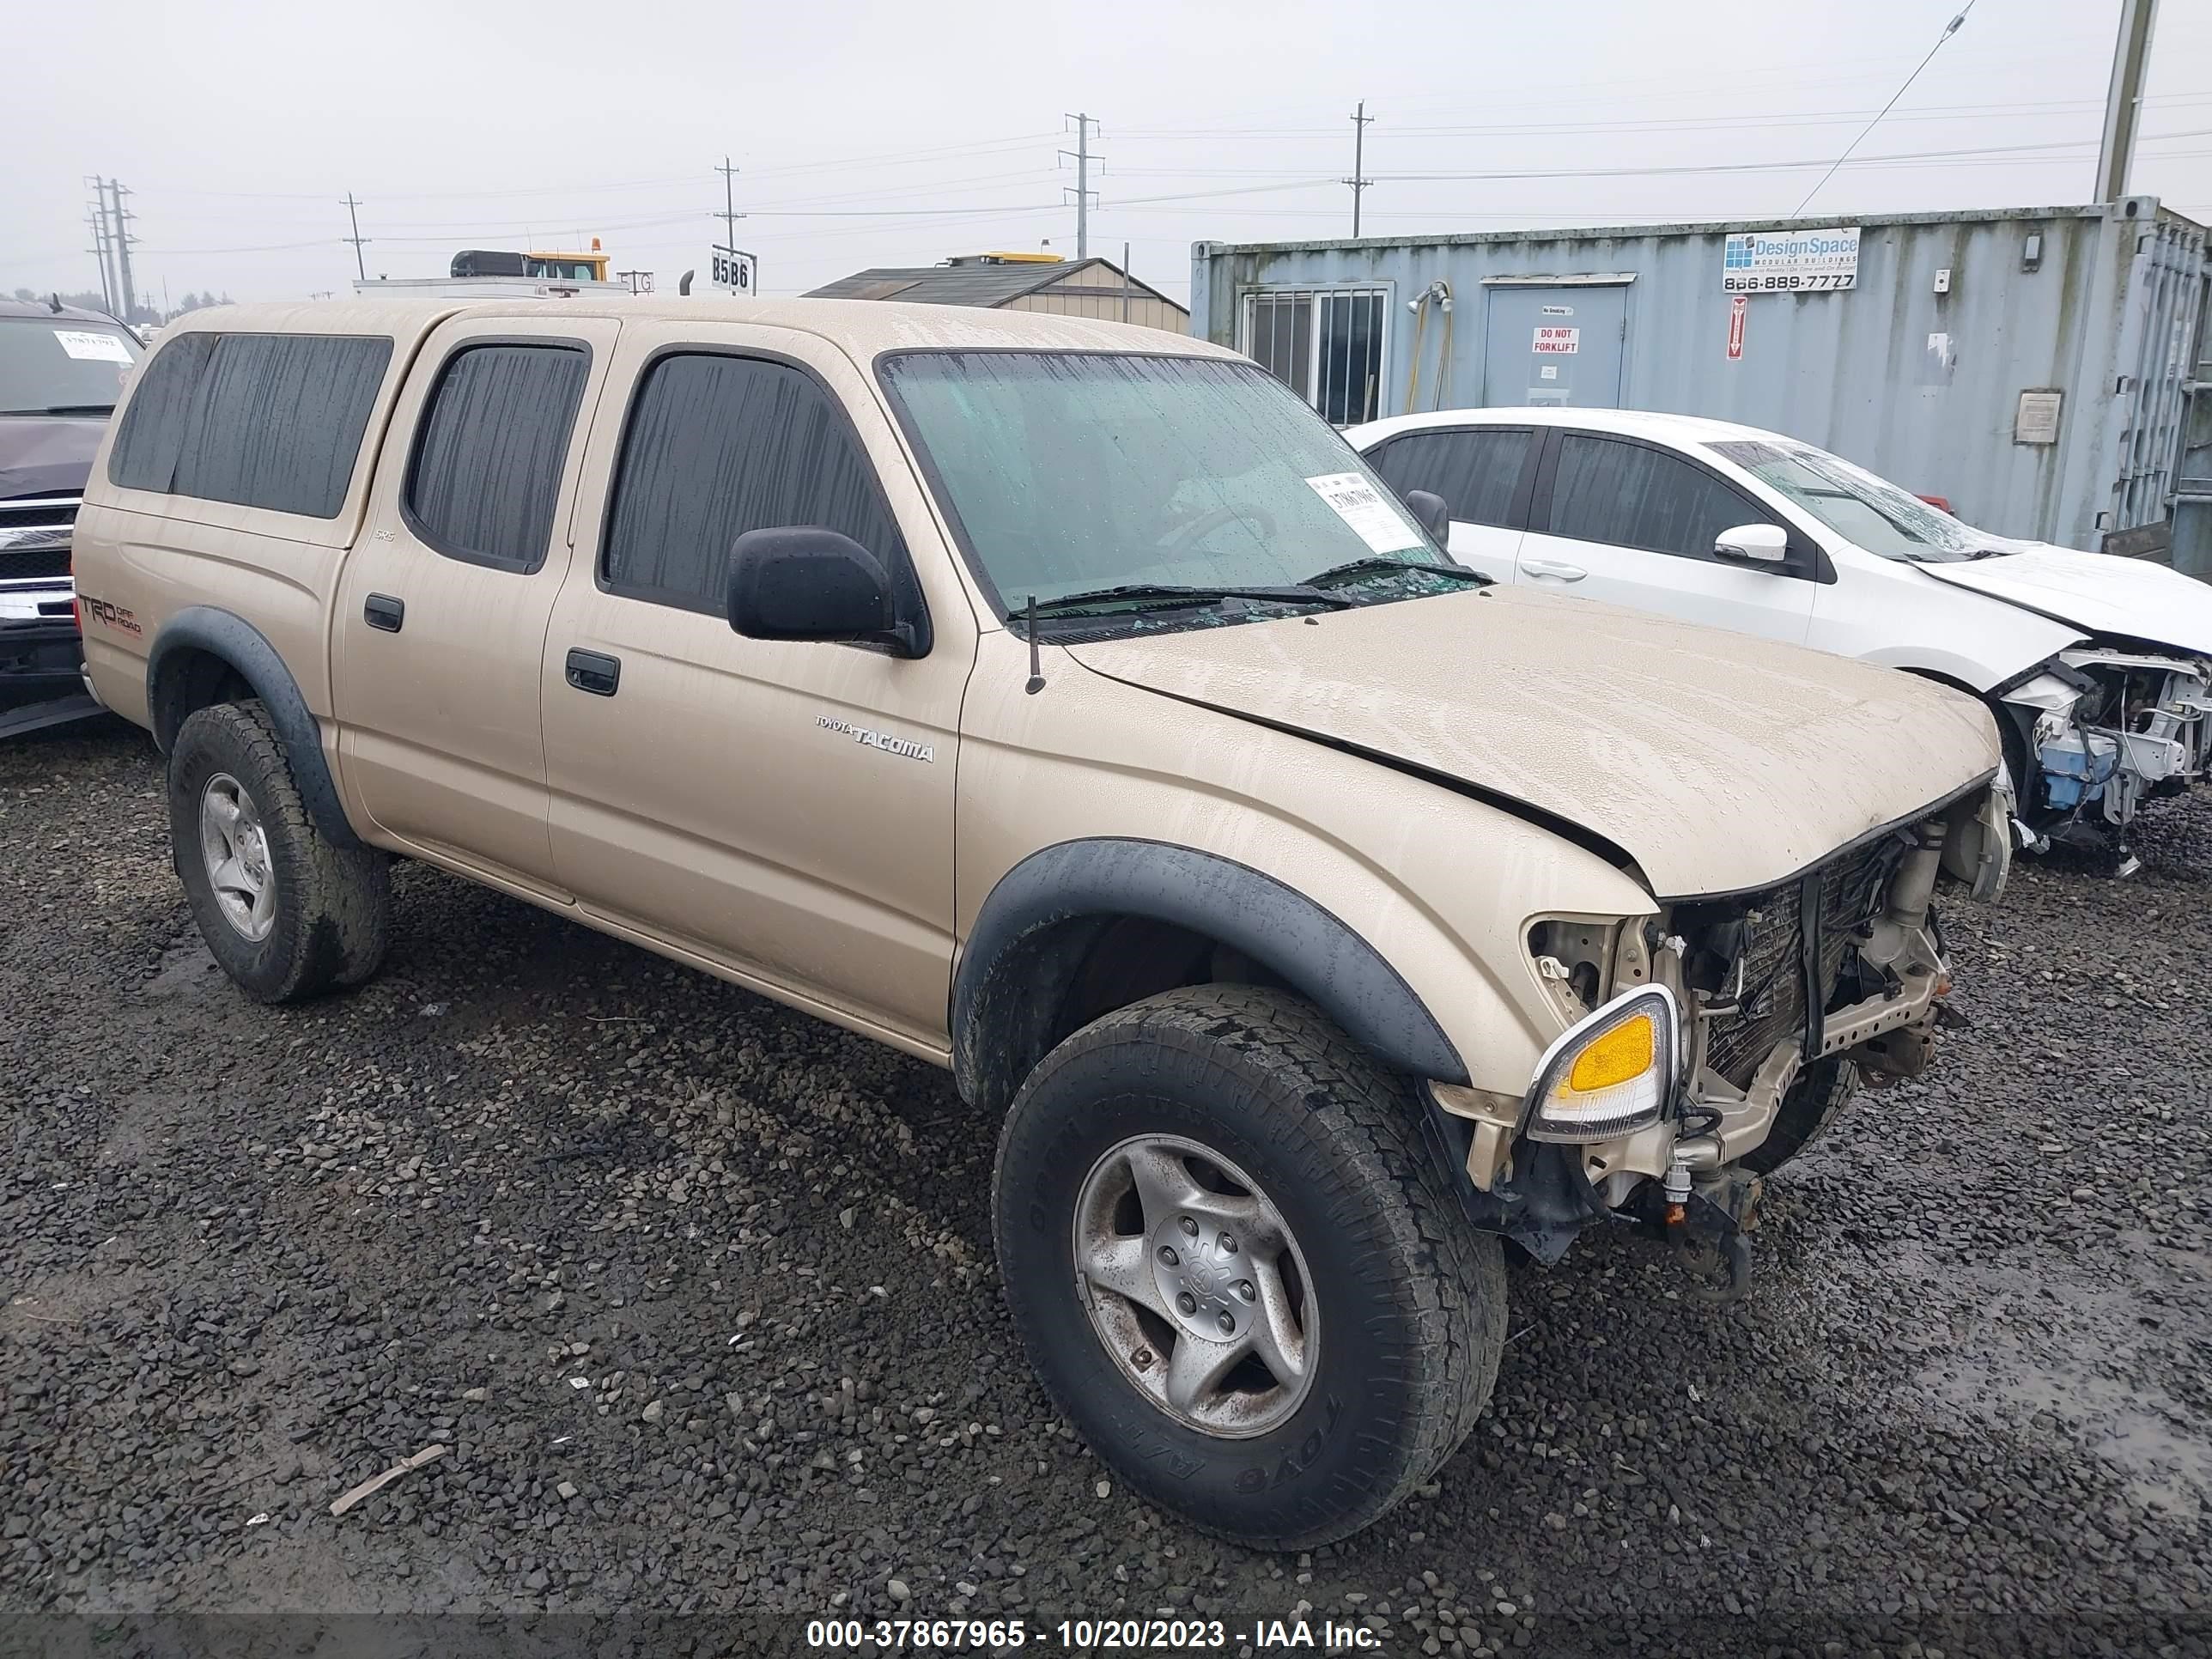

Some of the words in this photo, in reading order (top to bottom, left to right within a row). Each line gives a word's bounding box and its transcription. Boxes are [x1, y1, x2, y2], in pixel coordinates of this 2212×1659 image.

[1755, 238, 1857, 258] DesignSpace
[1724, 274, 1855, 290] 866-889-7777
[1540, 329, 1553, 338] DO
[1555, 329, 1572, 339] NOT
[1534, 343, 1577, 352] FORKLIFT
[79, 594, 116, 625] TRD
[117, 606, 134, 618] OFF
[118, 617, 142, 633] ROAD
[816, 714, 854, 736] TOYOTA
[855, 727, 934, 763] TACOMA
